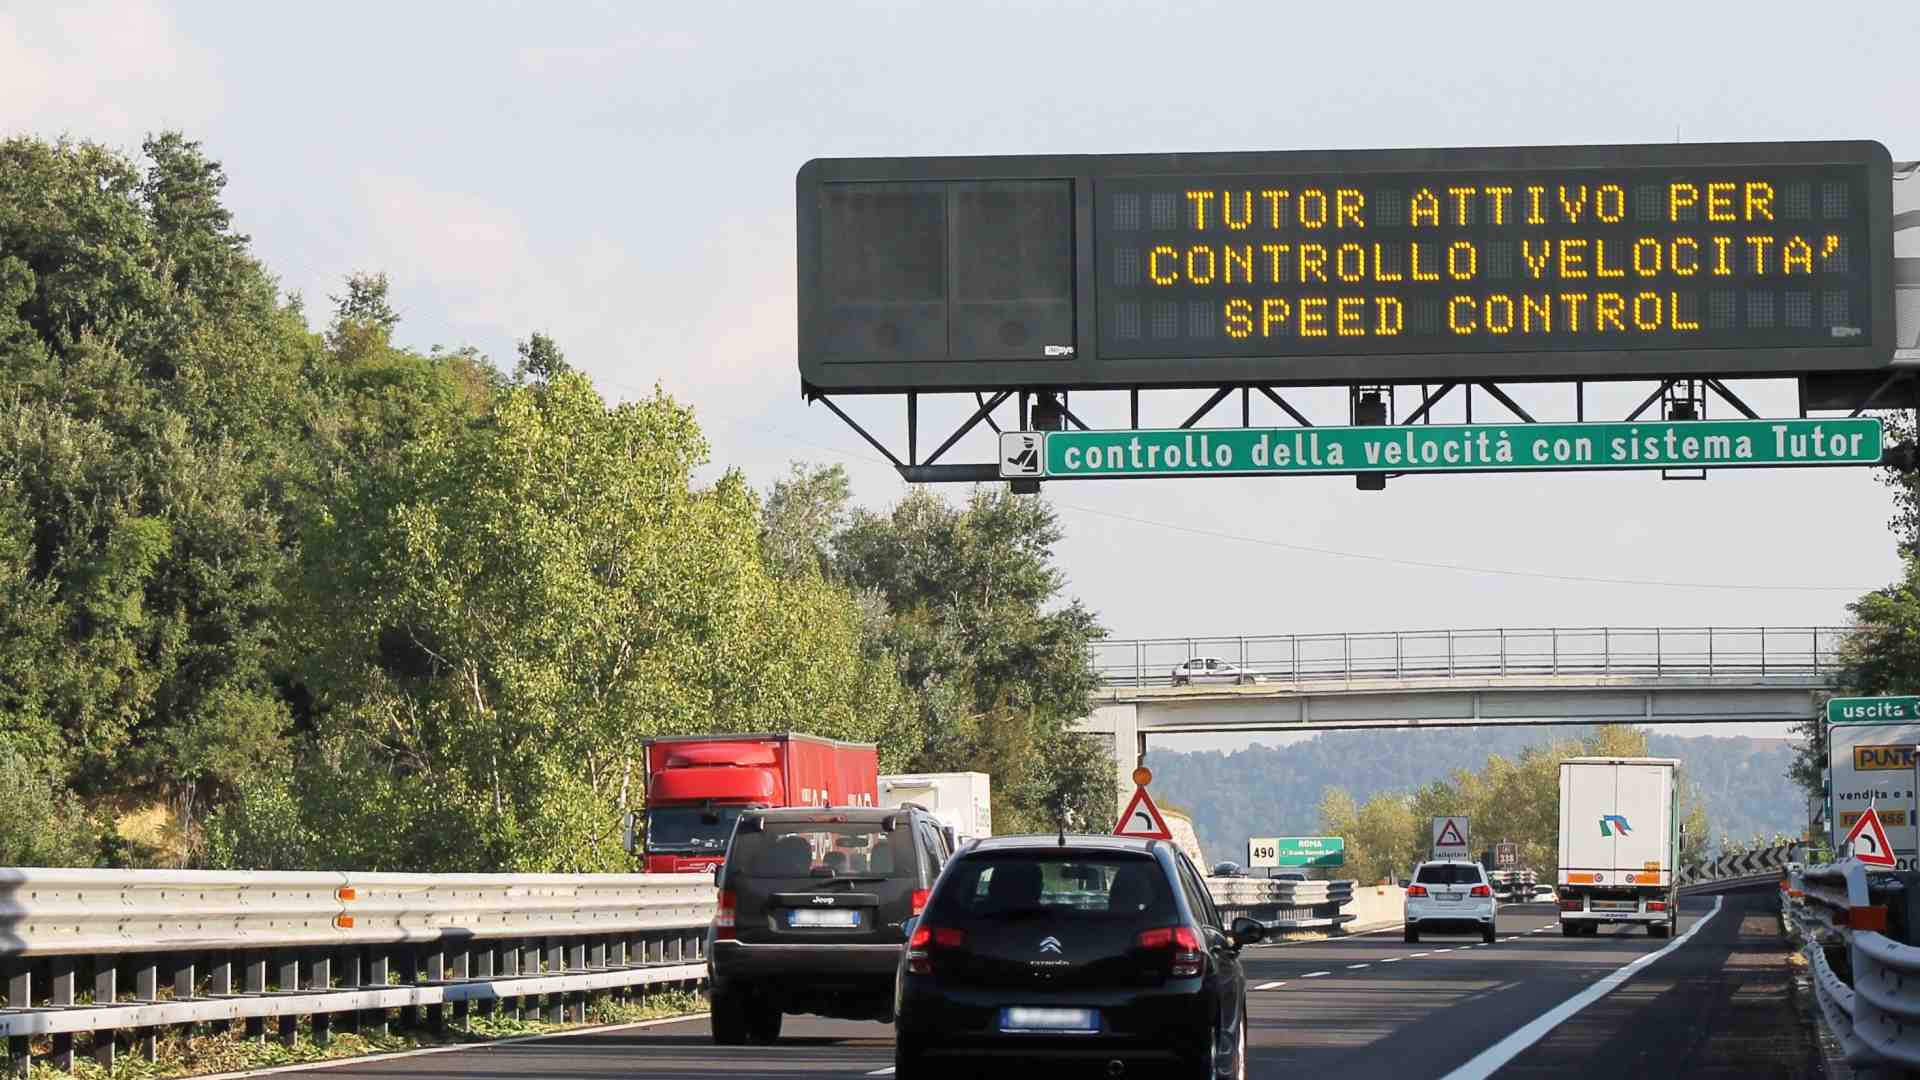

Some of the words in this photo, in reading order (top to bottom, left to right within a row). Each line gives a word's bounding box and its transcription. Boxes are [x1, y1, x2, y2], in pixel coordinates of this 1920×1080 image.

[1186, 188, 1365, 231] TUTOR
[1409, 184, 1625, 228] ATTIVO
[1669, 181, 1775, 222] PER
[1149, 240, 1477, 286] CONTROLLO
[1522, 234, 1840, 280] VELOCITA'
[1224, 295, 1404, 339] SPEED
[1447, 291, 1699, 336] CONTROL
[1065, 434, 1233, 471] controllo
[1252, 432, 1344, 468] della
[1364, 430, 1513, 467] velocità
[1532, 437, 1592, 462] con
[1611, 428, 1753, 462] sistema
[1773, 425, 1864, 458] Tutor
[1843, 703, 1904, 718] uscita
[1840, 789, 1888, 800] vendita
[1253, 847, 1275, 858] 490
[812, 896, 835, 905] Jeep
